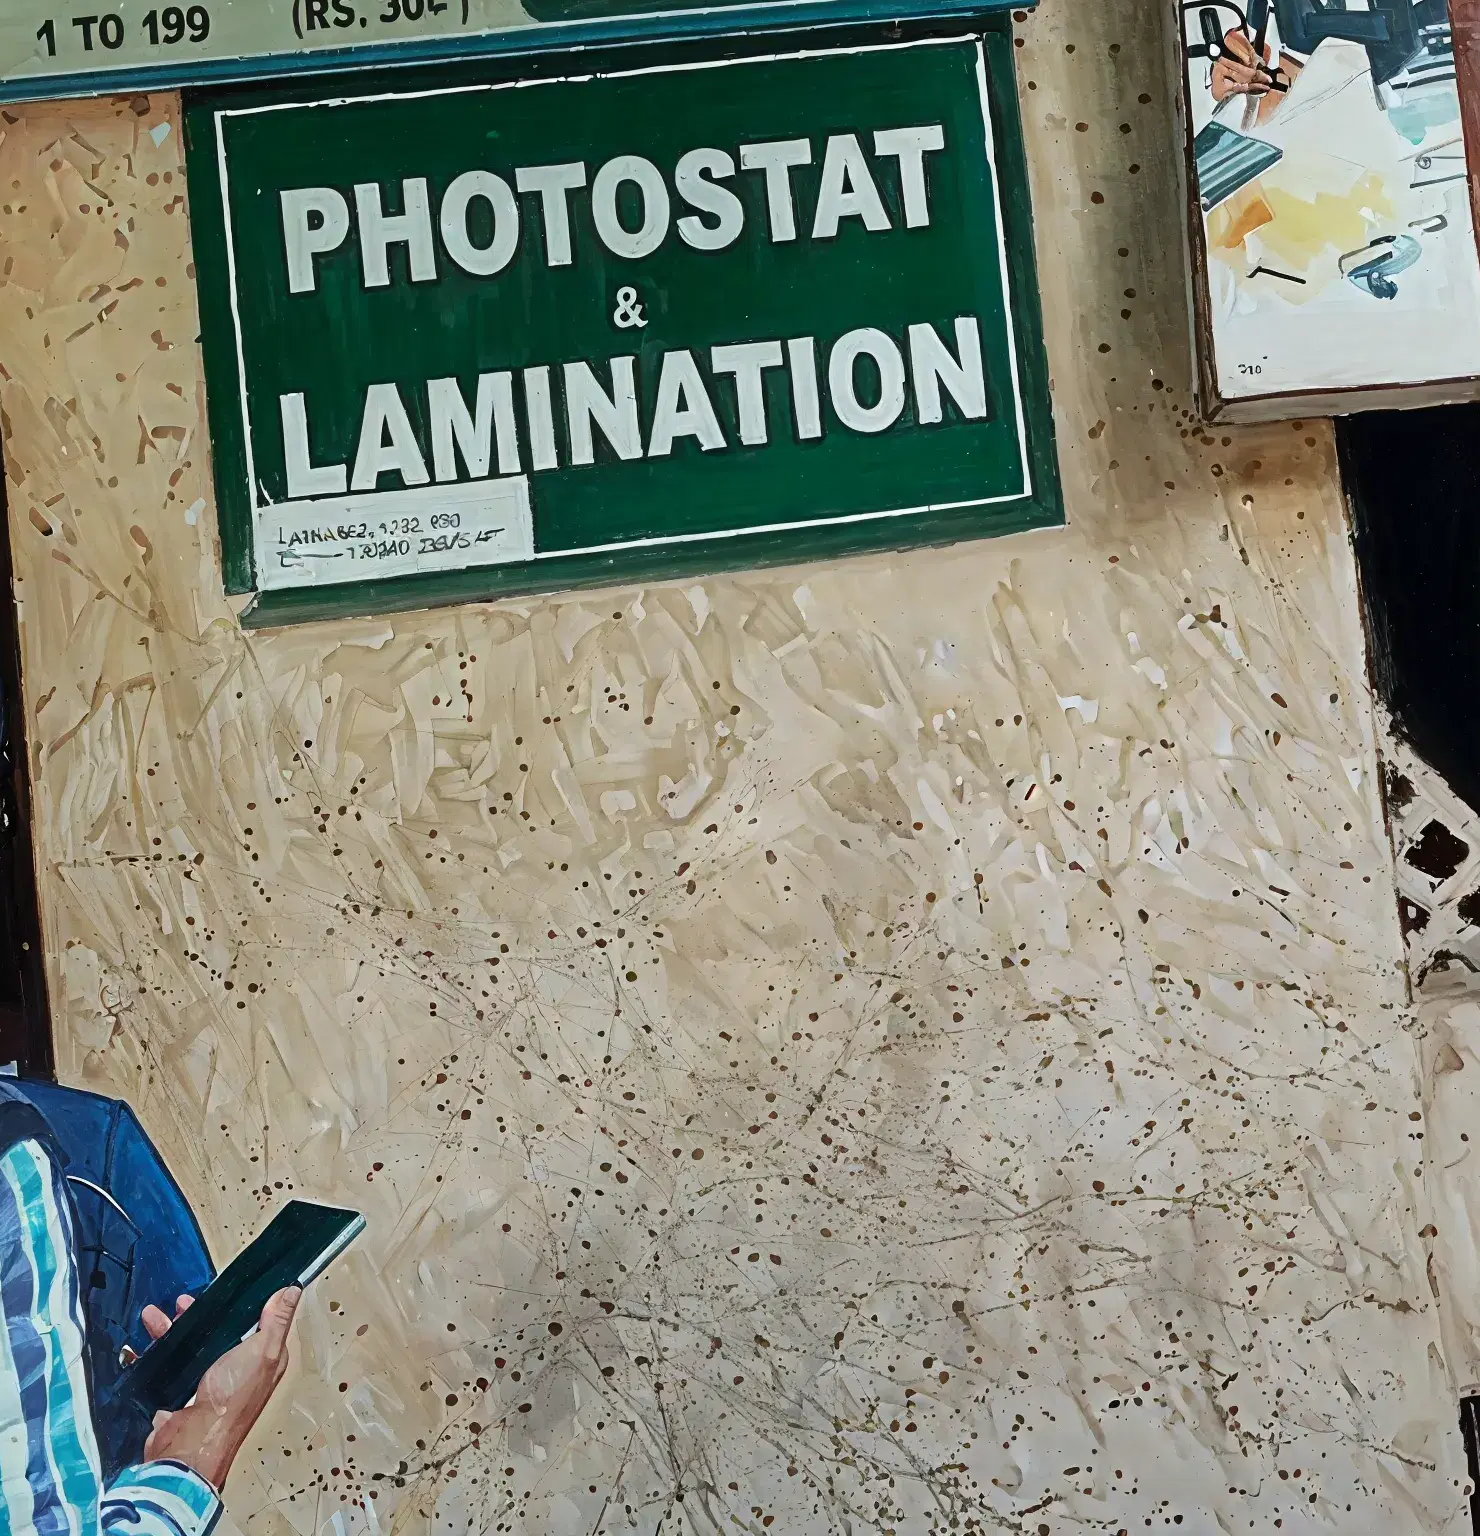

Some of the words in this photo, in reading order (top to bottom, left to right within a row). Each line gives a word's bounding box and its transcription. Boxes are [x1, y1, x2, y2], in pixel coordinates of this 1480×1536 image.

[36, 19, 57, 57] 1
[71, 13, 125, 51] TO
[141, 4, 211, 46] 199
[279, 124, 945, 296] PHOTOSTAT
[612, 285, 649, 329] &
[278, 316, 988, 500] LAMINATION
